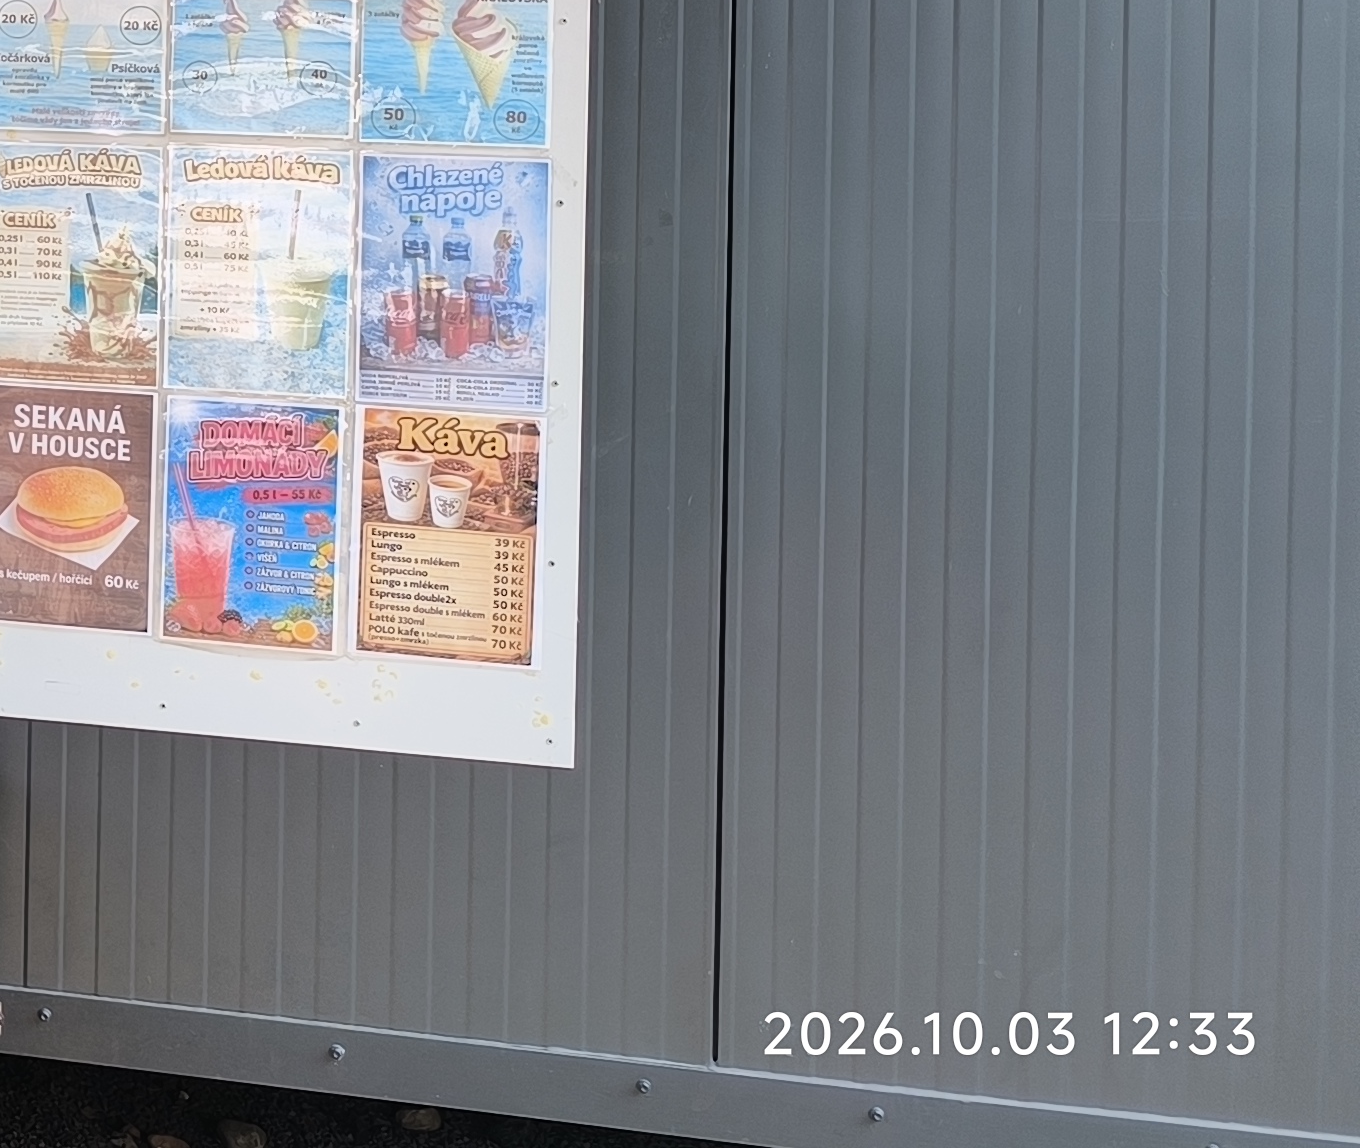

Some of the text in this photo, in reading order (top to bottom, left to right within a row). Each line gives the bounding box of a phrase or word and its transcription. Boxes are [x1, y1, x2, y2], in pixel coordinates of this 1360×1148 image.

[2, 14, 16, 23] 20
[124, 21, 138, 30] 20
[112, 64, 160, 73] Psíčková
[311, 70, 327, 79] 40
[384, 109, 404, 120] 50
[506, 111, 527, 123] 80
[5, 148, 141, 174] LEDOVÁ KÁVA
[184, 155, 340, 184] Ledová káva
[13, 175, 65, 187] TOČENOU
[387, 162, 504, 191] Chlazené
[400, 186, 502, 217] nápoje
[3, 211, 56, 228] CENÍK
[190, 205, 243, 223] CENÍK
[14, 404, 126, 434] SEKANÁ
[201, 415, 303, 448] DOMÁCÍ
[397, 417, 508, 459] Káva
[32, 434, 131, 461] HOUSCE
[189, 448, 328, 481] LIMONÁDY
[292, 490, 305, 499] 55
[372, 528, 416, 539] Espresso
[371, 540, 402, 552] Lungo
[371, 553, 509, 572] Espresso mlékem 45
[104, 575, 123, 588] 60
[371, 565, 508, 584] Cappuccino 50
[370, 577, 508, 597] Lungo mlékem 50
[370, 589, 507, 609] Espresso 50
[370, 601, 507, 622] Espresso double 60
[369, 613, 506, 634] Latté 330ml 70
[369, 625, 506, 649] POLO kafe 70
